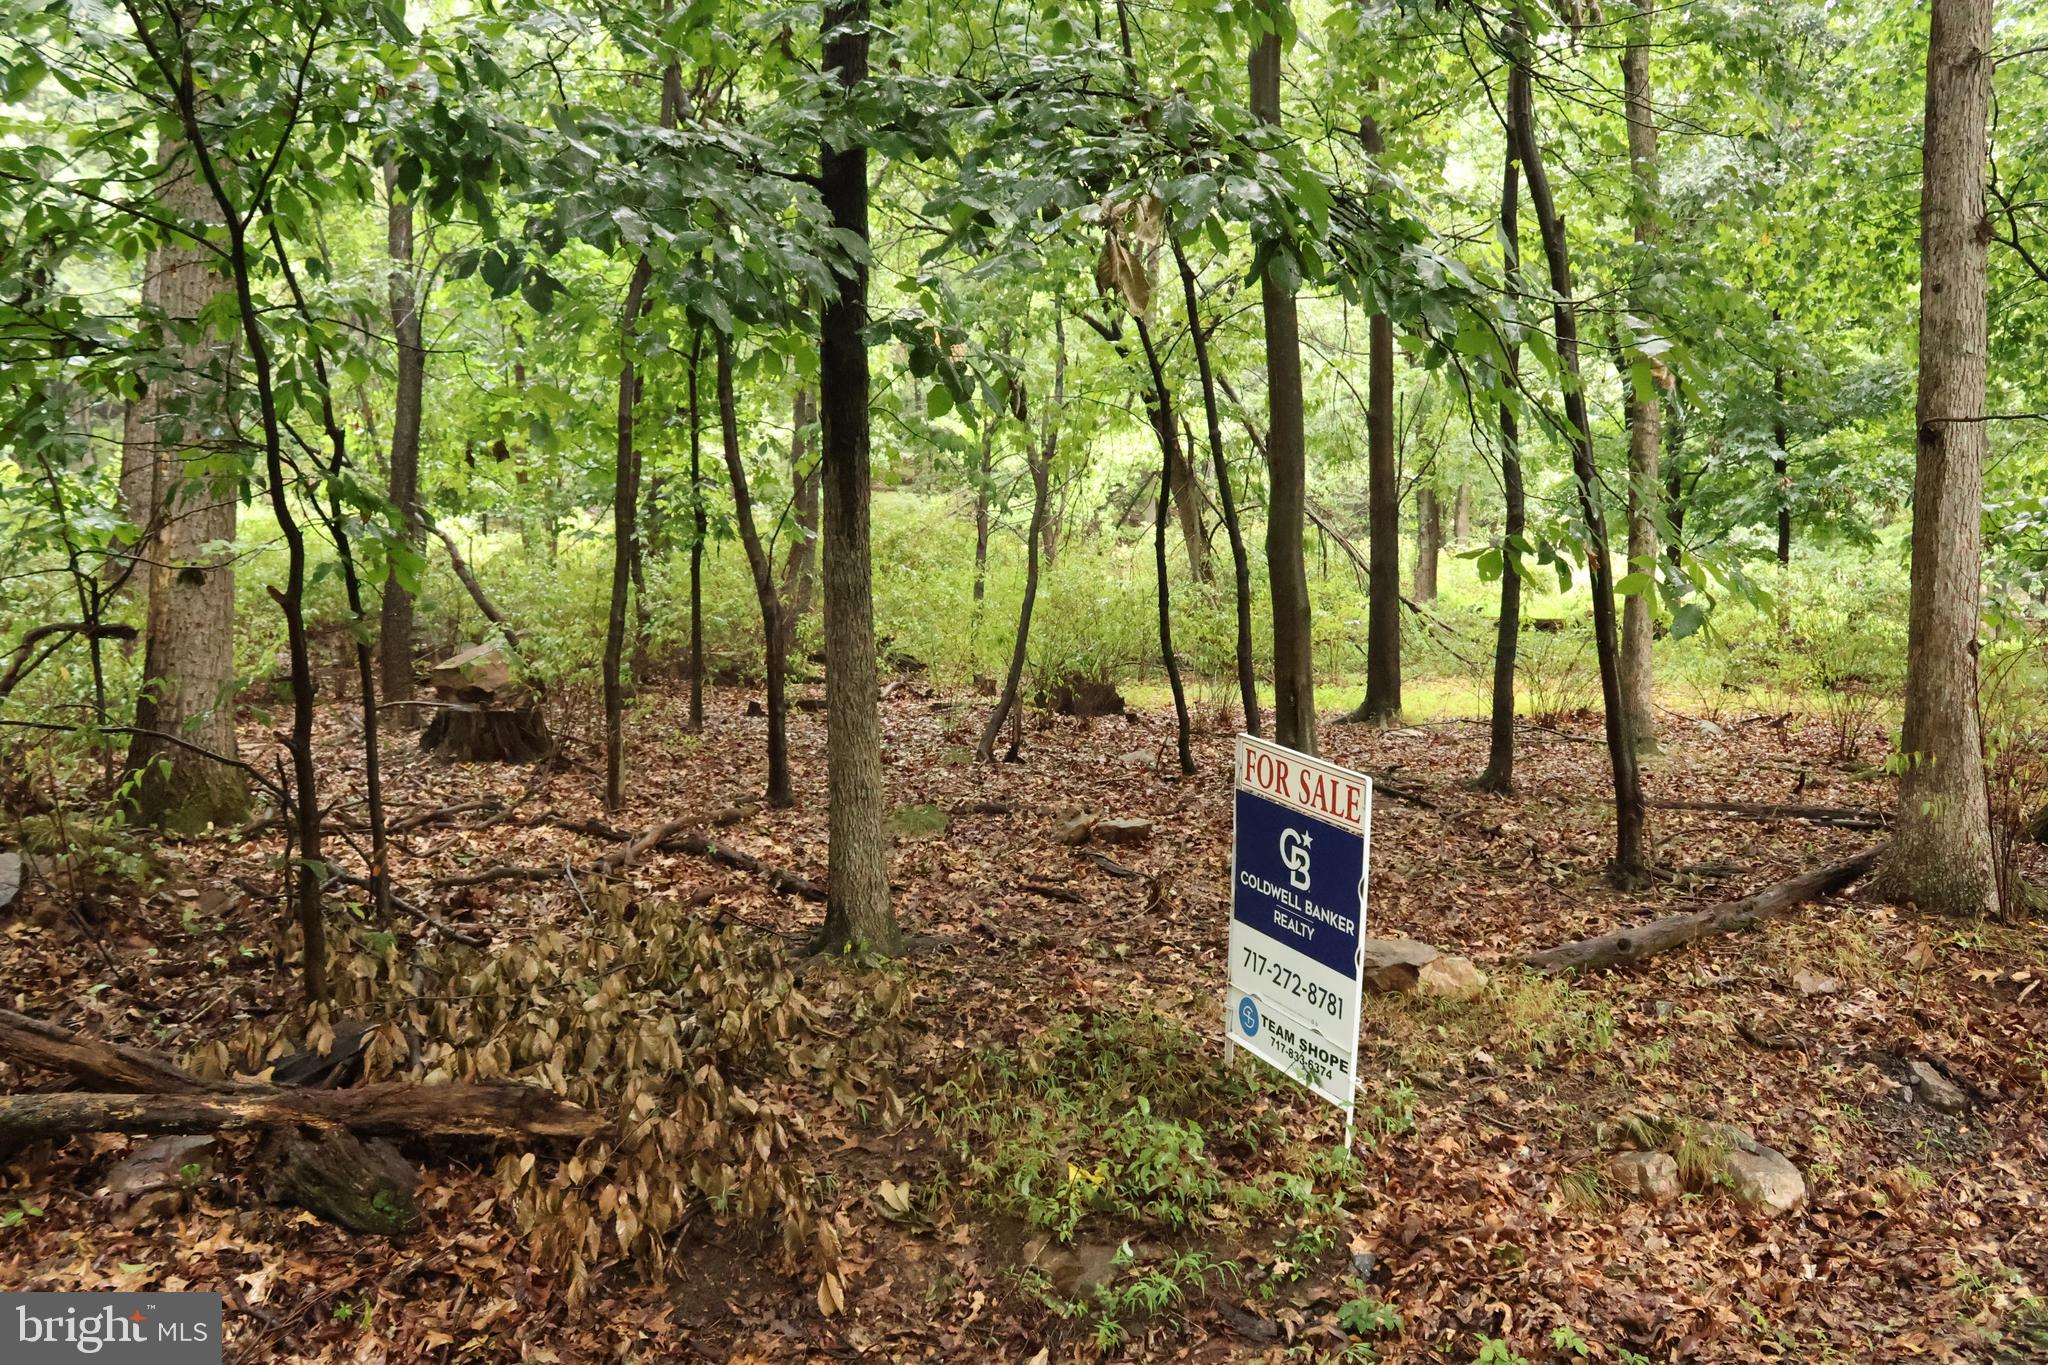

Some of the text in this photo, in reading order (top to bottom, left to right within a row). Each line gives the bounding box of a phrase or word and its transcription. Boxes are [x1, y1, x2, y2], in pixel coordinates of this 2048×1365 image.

[1244, 748, 1361, 824] FOR SALE
[1240, 870, 1355, 937] COLDWELL BANKER
[1273, 909, 1315, 941] REALTY
[1243, 946, 1343, 1020] 717-272-8781
[1261, 1014, 1349, 1074] TEAM SHOPE
[1270, 1036, 1333, 1081] 717-833-6374
